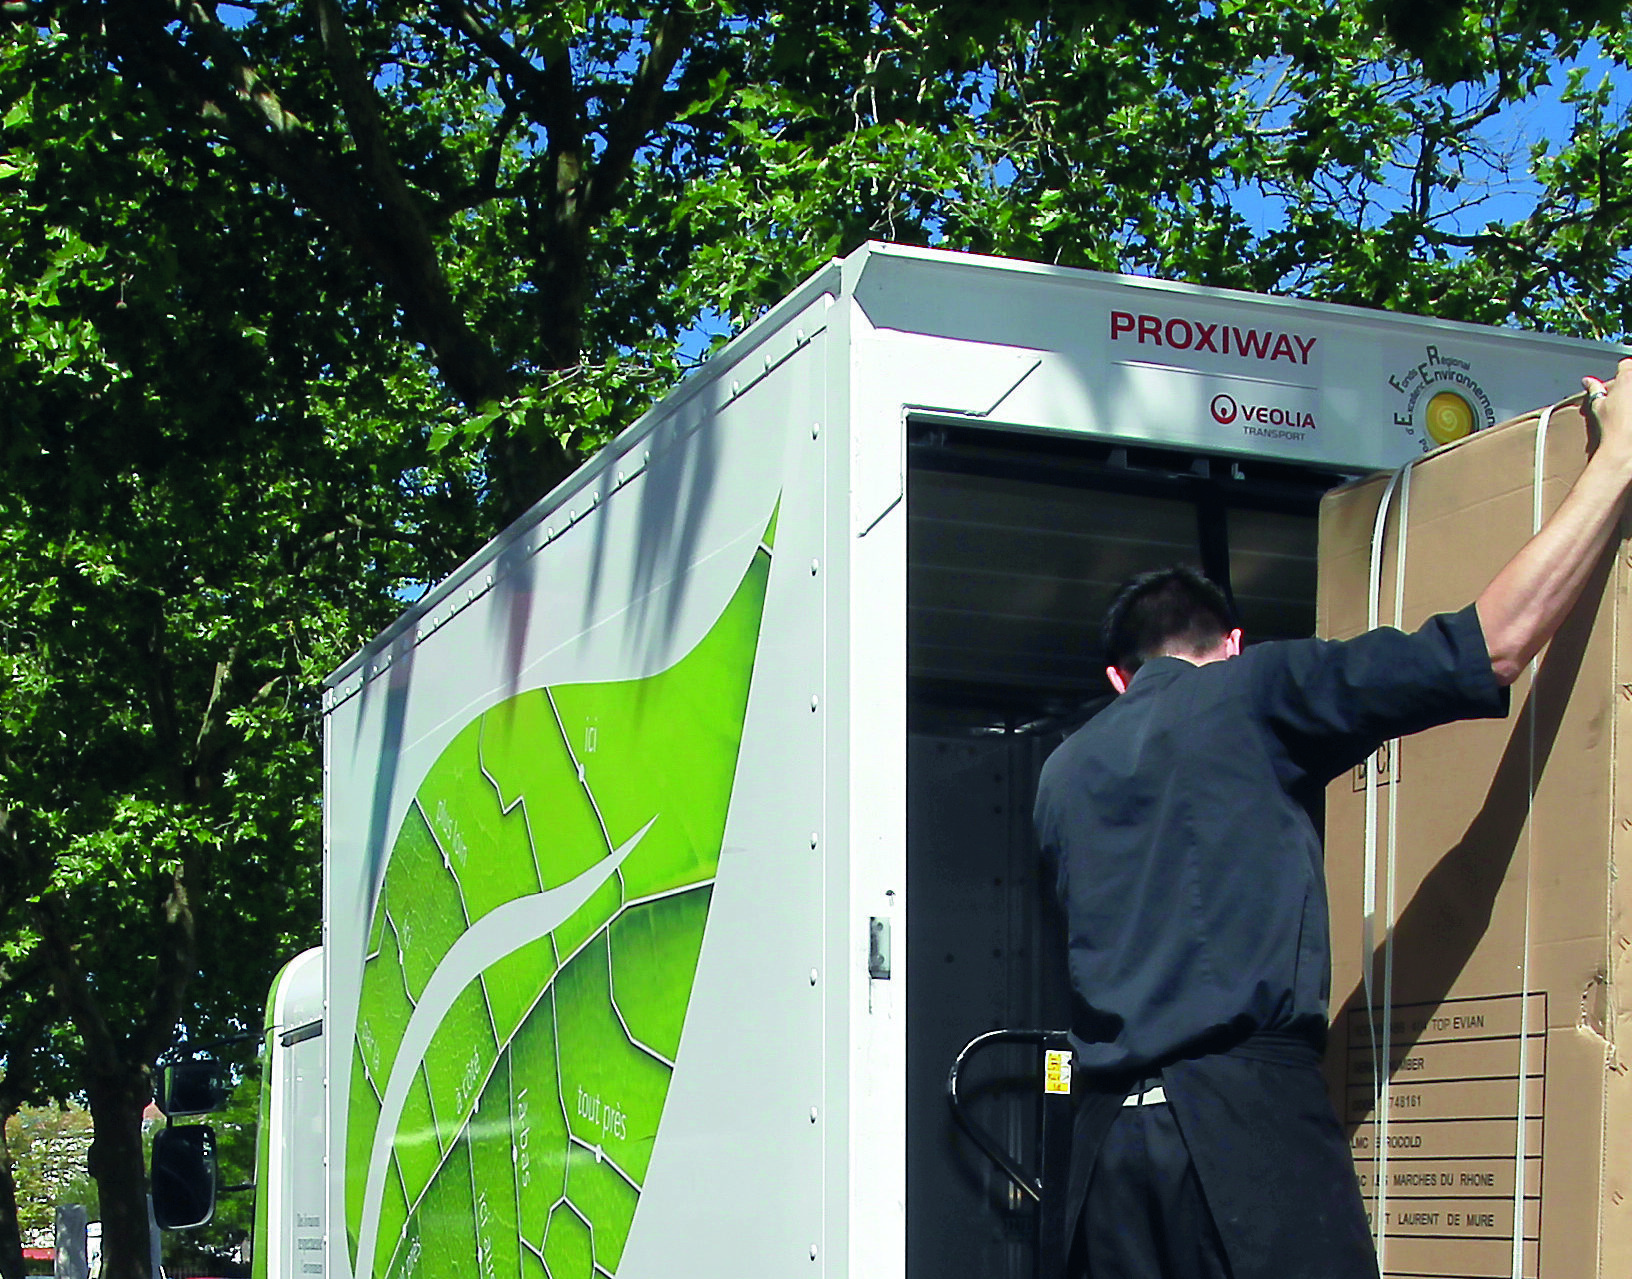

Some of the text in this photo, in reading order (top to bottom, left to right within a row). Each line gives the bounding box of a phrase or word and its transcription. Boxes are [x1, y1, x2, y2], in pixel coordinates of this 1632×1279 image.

[1110, 310, 1317, 365] PROXIWAY
[1418, 361, 1497, 428] Environnemen
[1241, 405, 1316, 429] VEOLIA
[1243, 425, 1306, 441] TRANSPORT
[1431, 1017, 1450, 1032] TOP
[1453, 1015, 1484, 1030] EVIAN
[1389, 1095, 1421, 1108] 748161
[577, 1084, 627, 1141] tout près
[1393, 1173, 1437, 1187] MARCHES
[1440, 1173, 1454, 1187] DU
[1460, 1173, 1495, 1187] RHONE
[1398, 1212, 1440, 1226] LAURENT
[1447, 1214, 1461, 1226] DE
[1466, 1213, 1495, 1227] MURE
